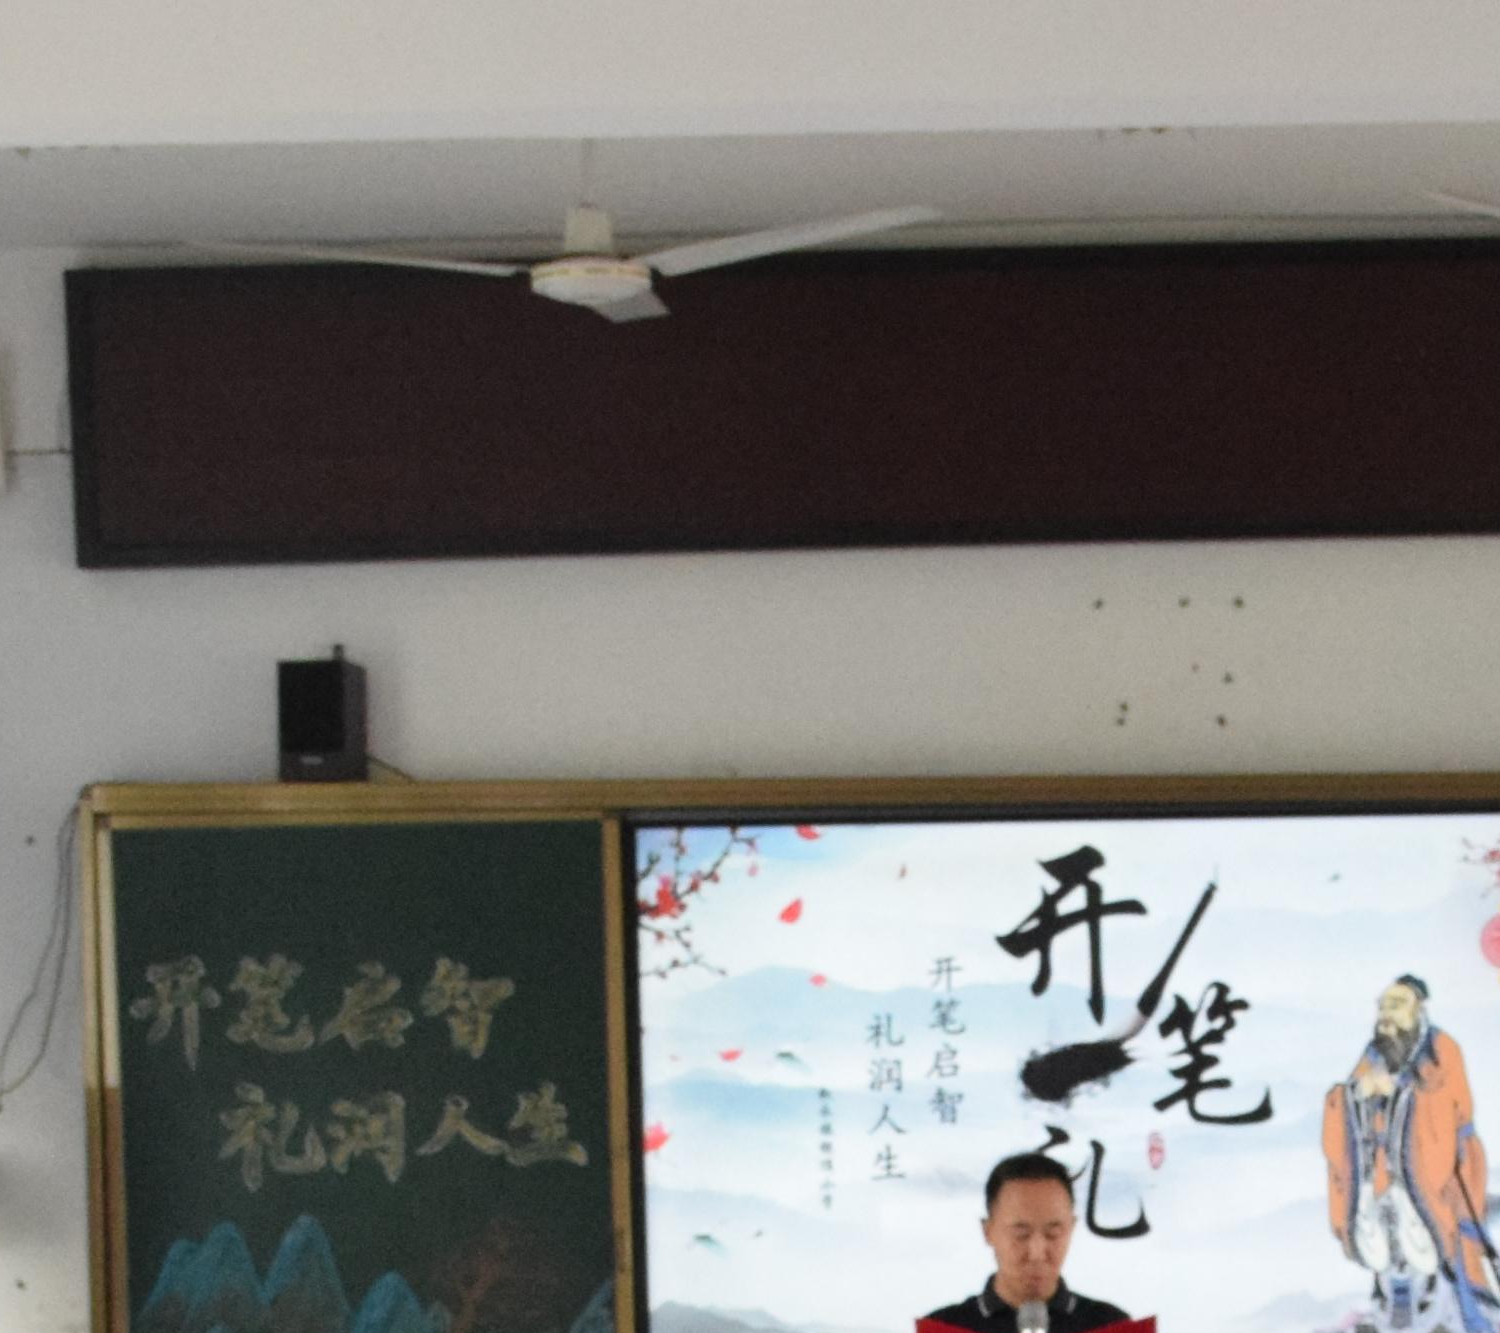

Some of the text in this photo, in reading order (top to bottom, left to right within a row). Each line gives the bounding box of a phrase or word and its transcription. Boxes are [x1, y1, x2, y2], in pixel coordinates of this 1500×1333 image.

[865, 1011, 907, 1181] 礼润人生
[926, 956, 968, 1124] 开笔启智
[218, 1081, 590, 1192] 礼润人生
